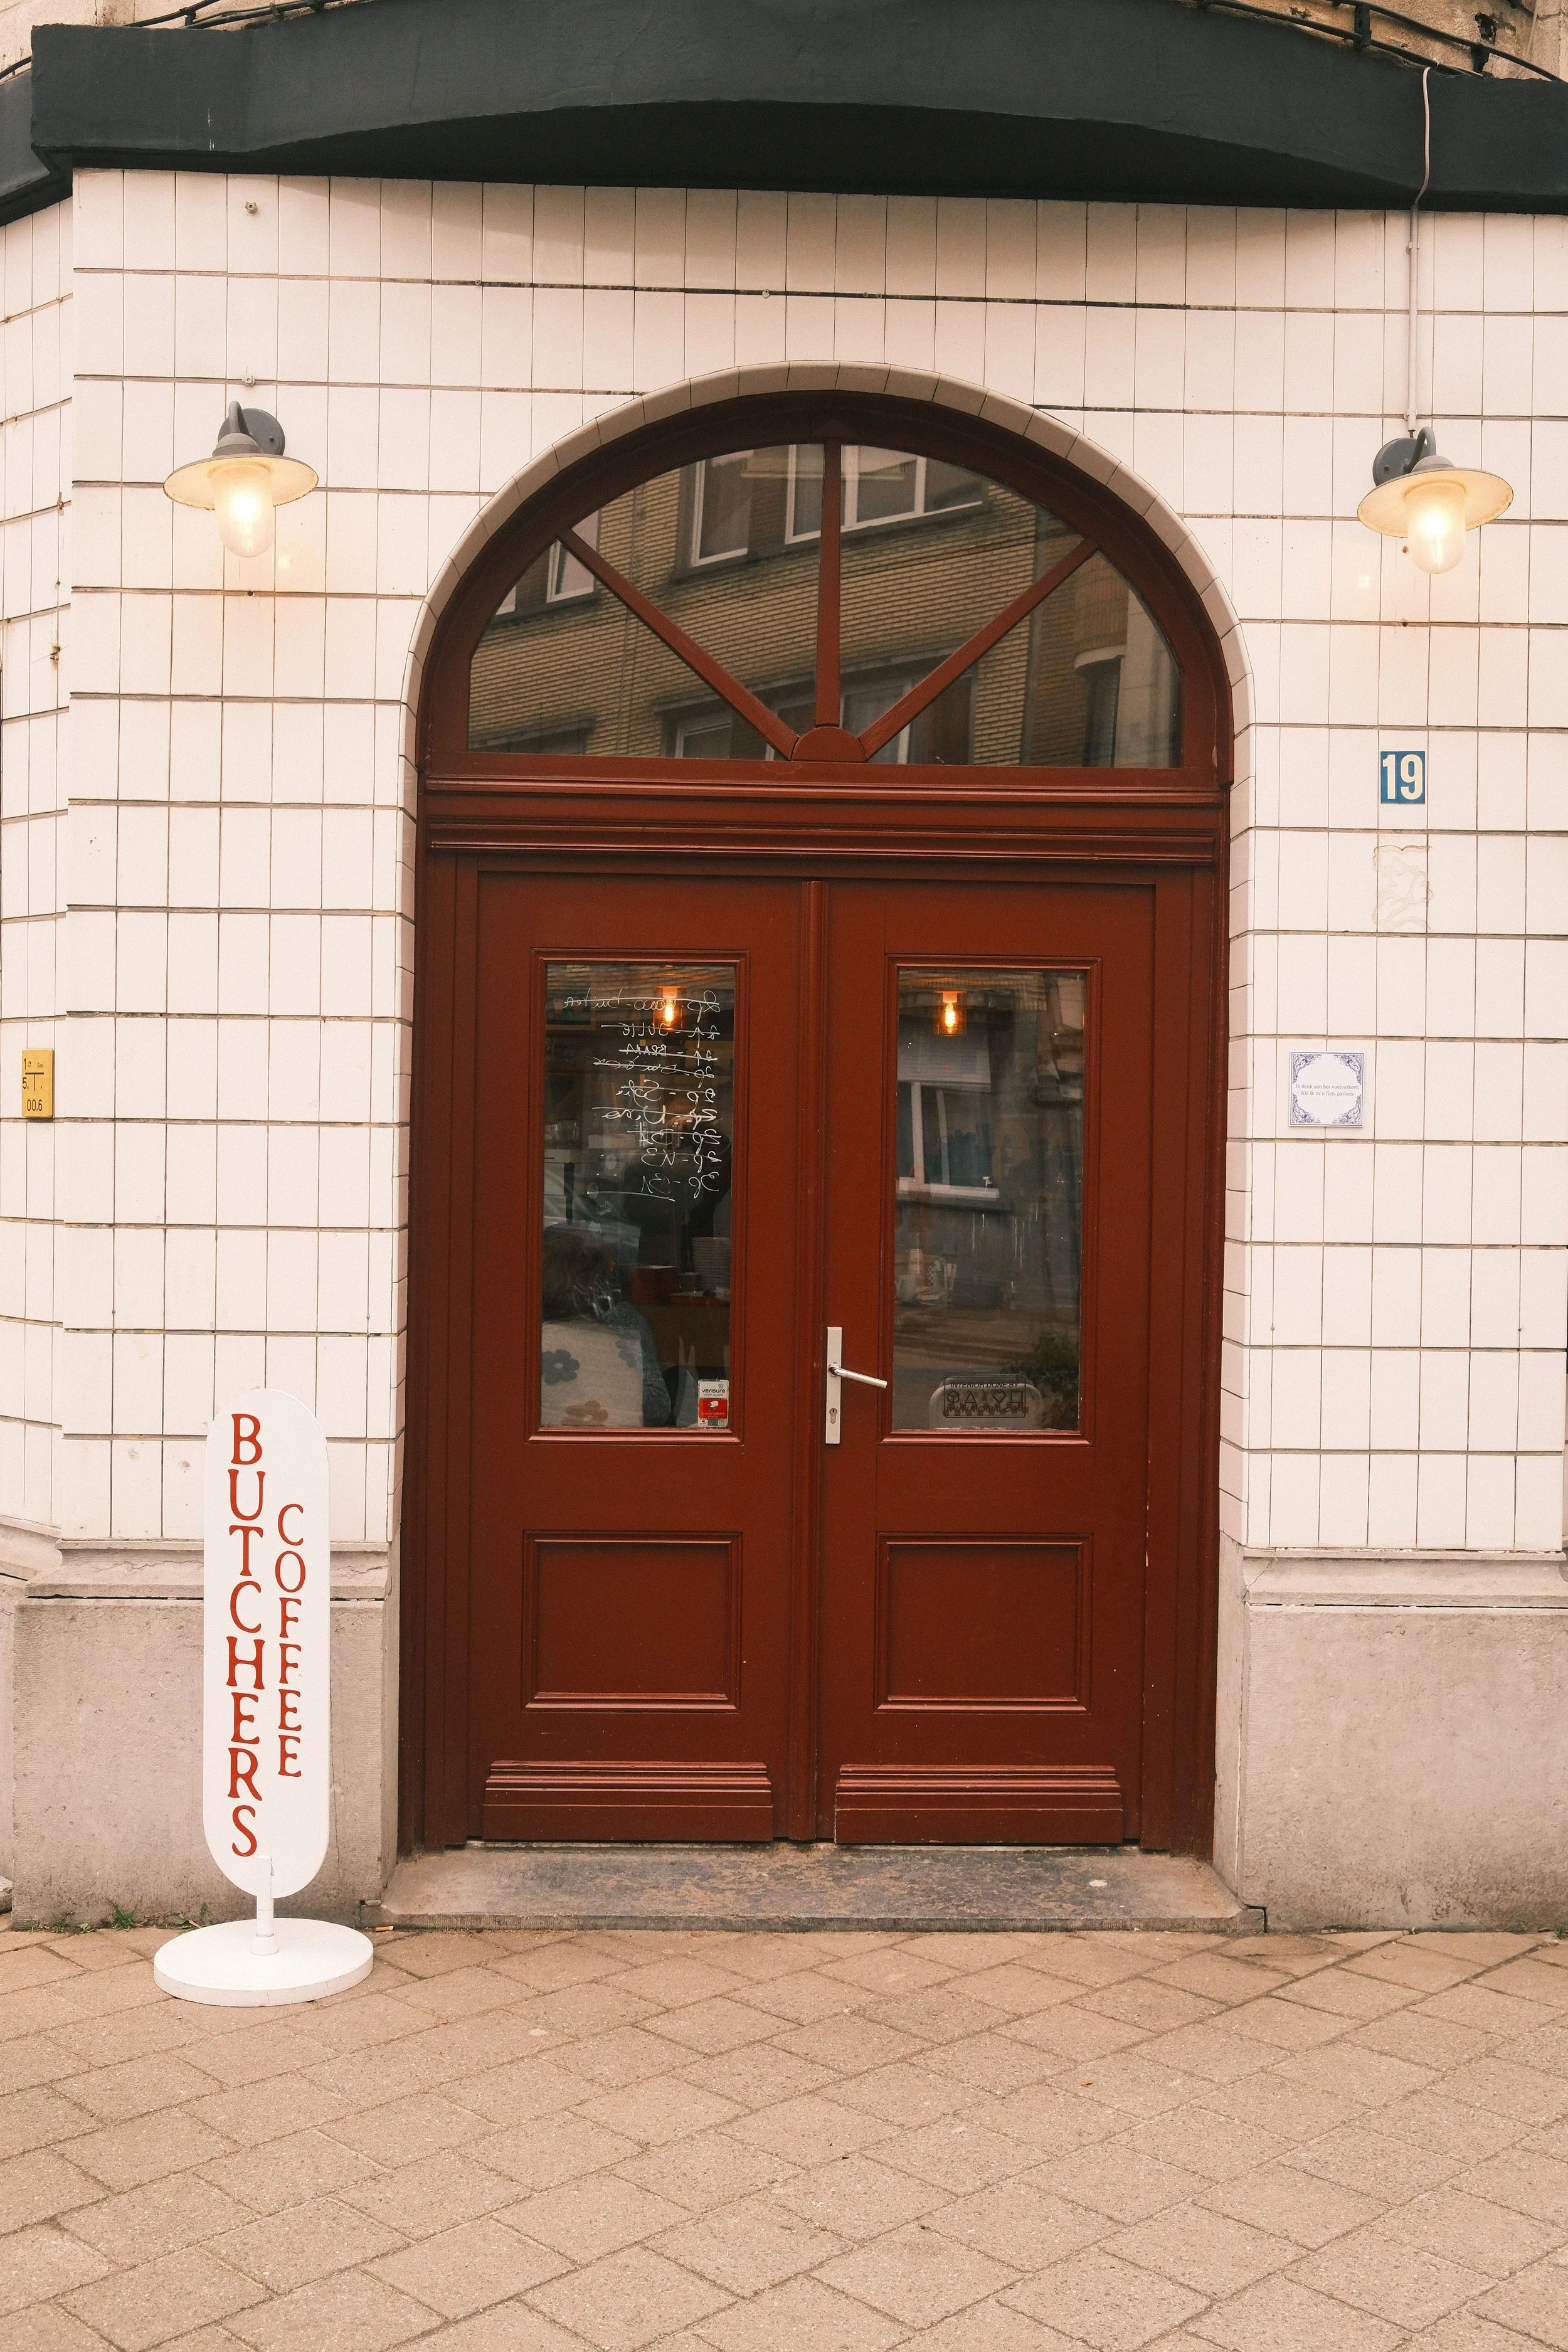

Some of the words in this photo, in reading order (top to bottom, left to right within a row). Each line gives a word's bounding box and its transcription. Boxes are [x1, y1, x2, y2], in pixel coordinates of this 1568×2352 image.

[1382, 754, 1422, 800] 19
[27, 1099, 43, 1111] 00,6
[226, 1413, 265, 1857] BUTCHERS
[275, 1503, 306, 1777] COFFEE
